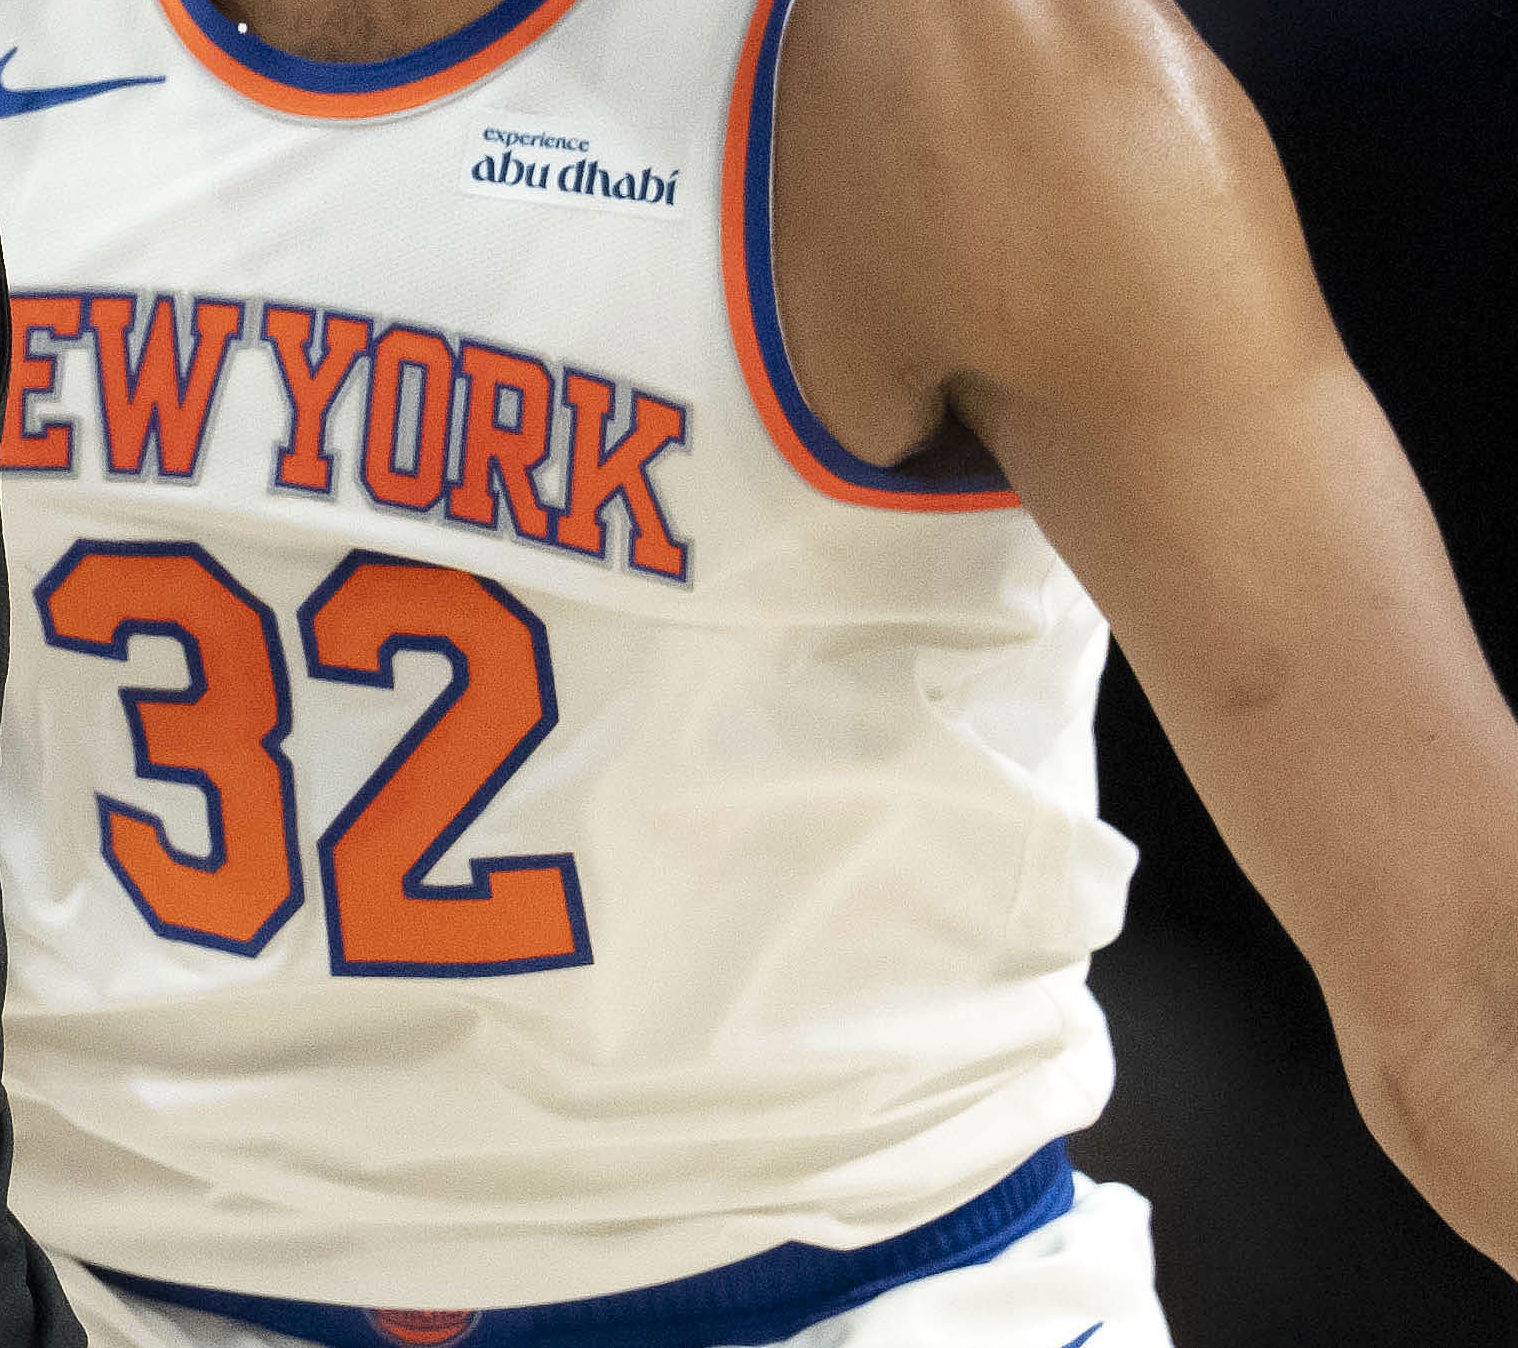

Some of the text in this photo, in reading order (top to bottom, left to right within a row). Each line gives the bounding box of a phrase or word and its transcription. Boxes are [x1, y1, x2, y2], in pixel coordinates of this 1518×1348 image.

[470, 149, 680, 207] abu dhabi
[483, 126, 590, 152] experience
[0, 289, 693, 591] EW YORK
[32, 537, 595, 978] 32
